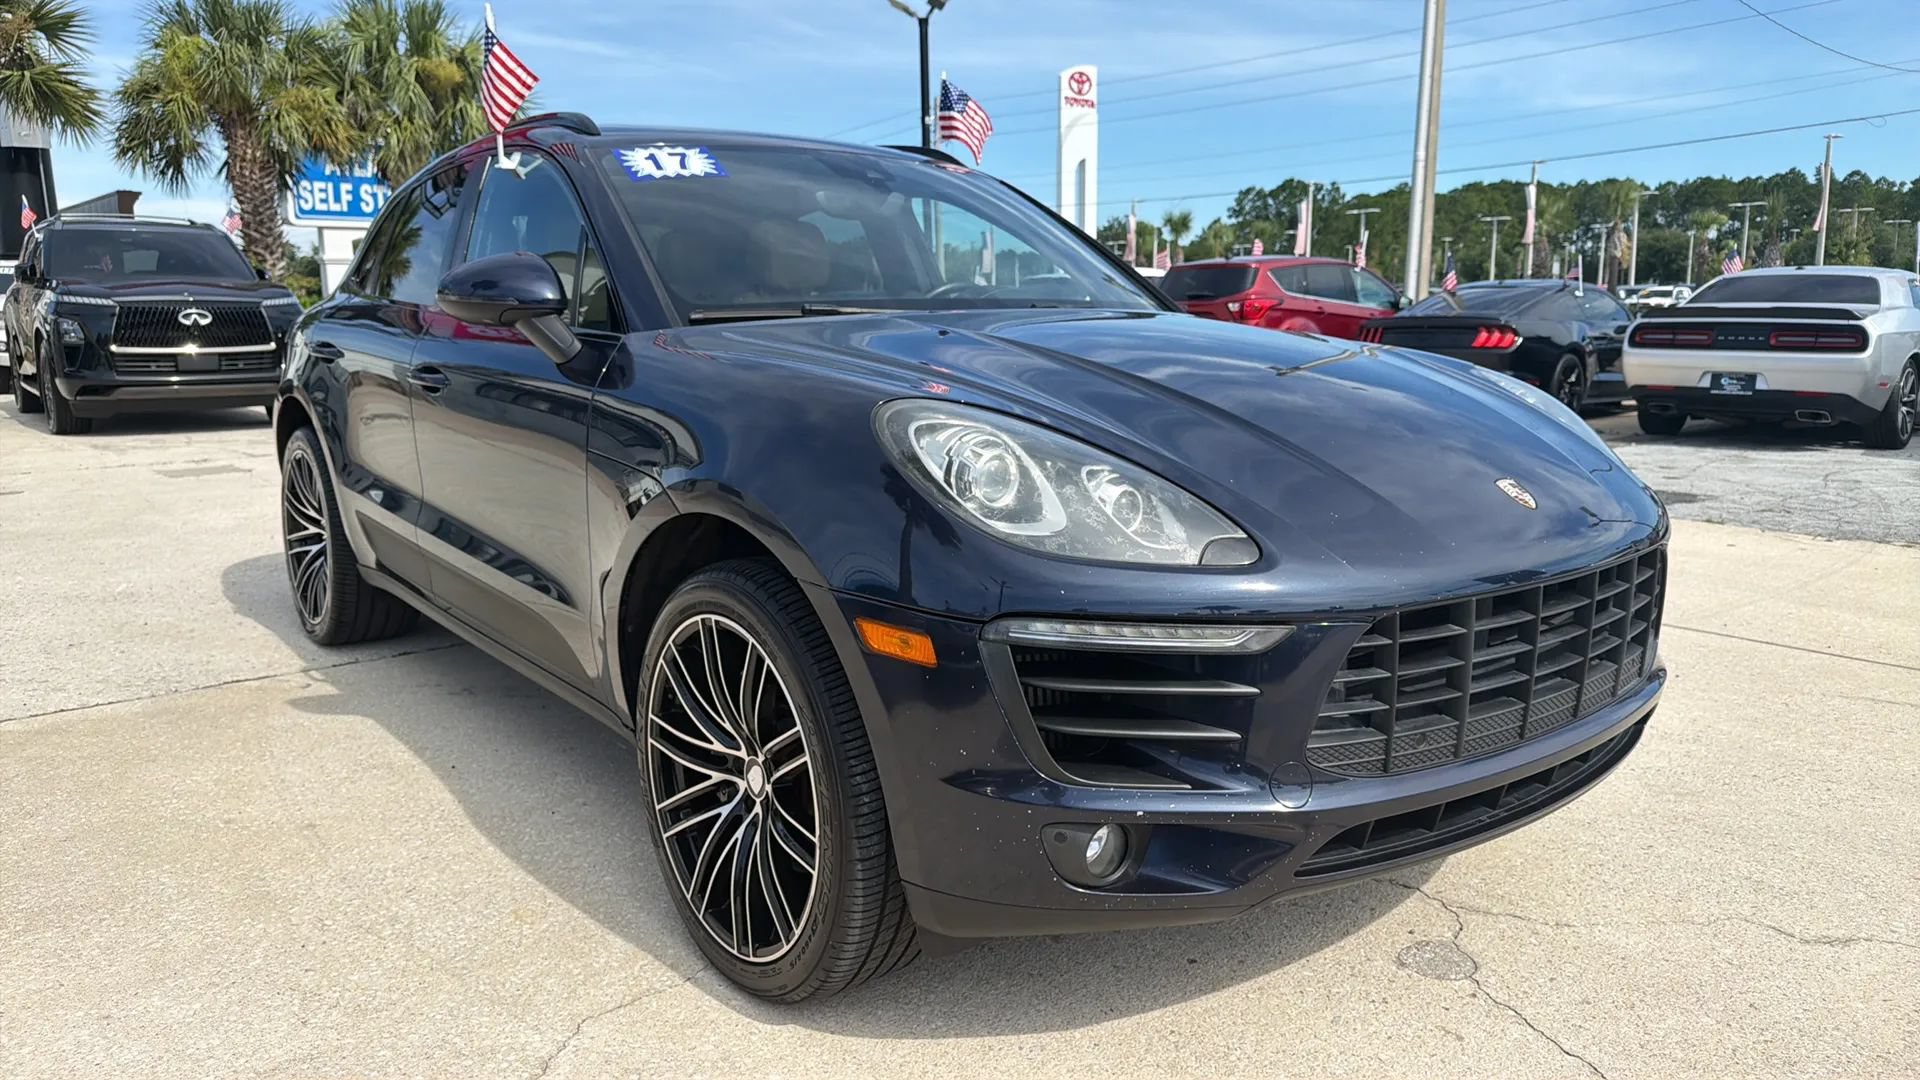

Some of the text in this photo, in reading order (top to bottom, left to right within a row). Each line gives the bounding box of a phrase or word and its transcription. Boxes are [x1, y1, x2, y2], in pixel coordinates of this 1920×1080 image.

[644, 153, 688, 171] 17
[299, 180, 392, 214] SELF ST
